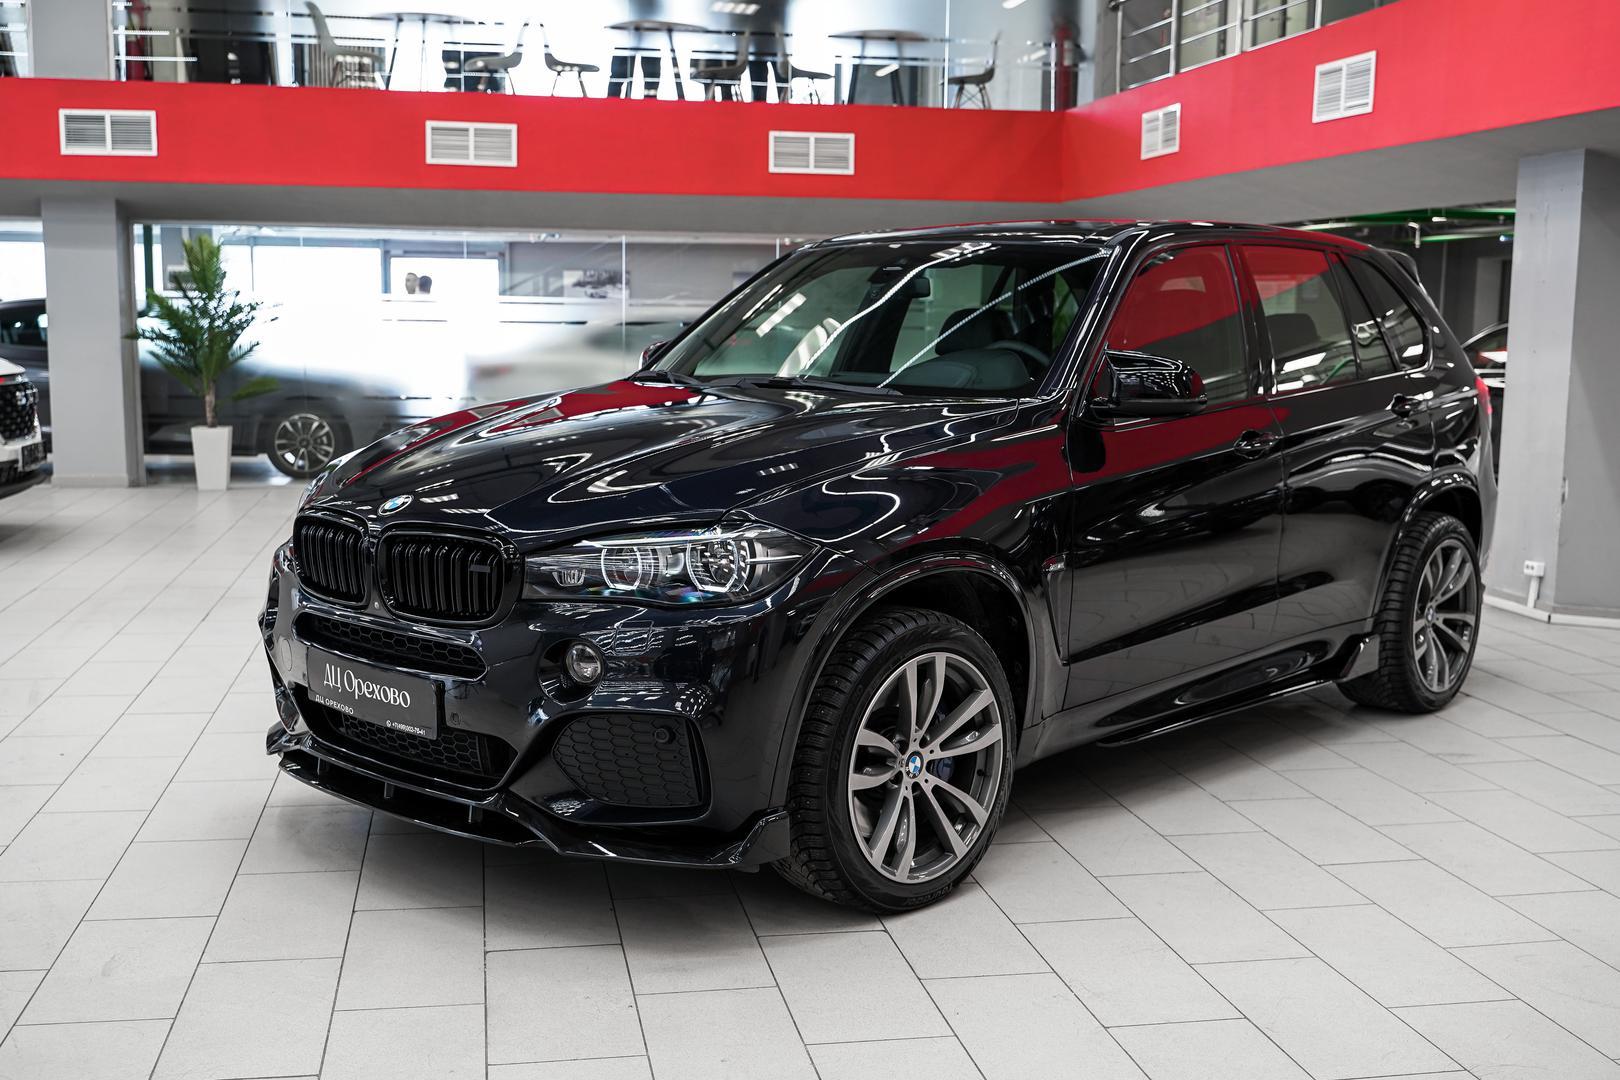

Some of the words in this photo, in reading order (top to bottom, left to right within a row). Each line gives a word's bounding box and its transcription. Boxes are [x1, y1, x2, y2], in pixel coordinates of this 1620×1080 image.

[323, 663, 342, 693] ДЦ
[344, 670, 411, 708] Орехово
[315, 694, 325, 705] ДЦ
[325, 698, 354, 715] ОРЕХОВО
